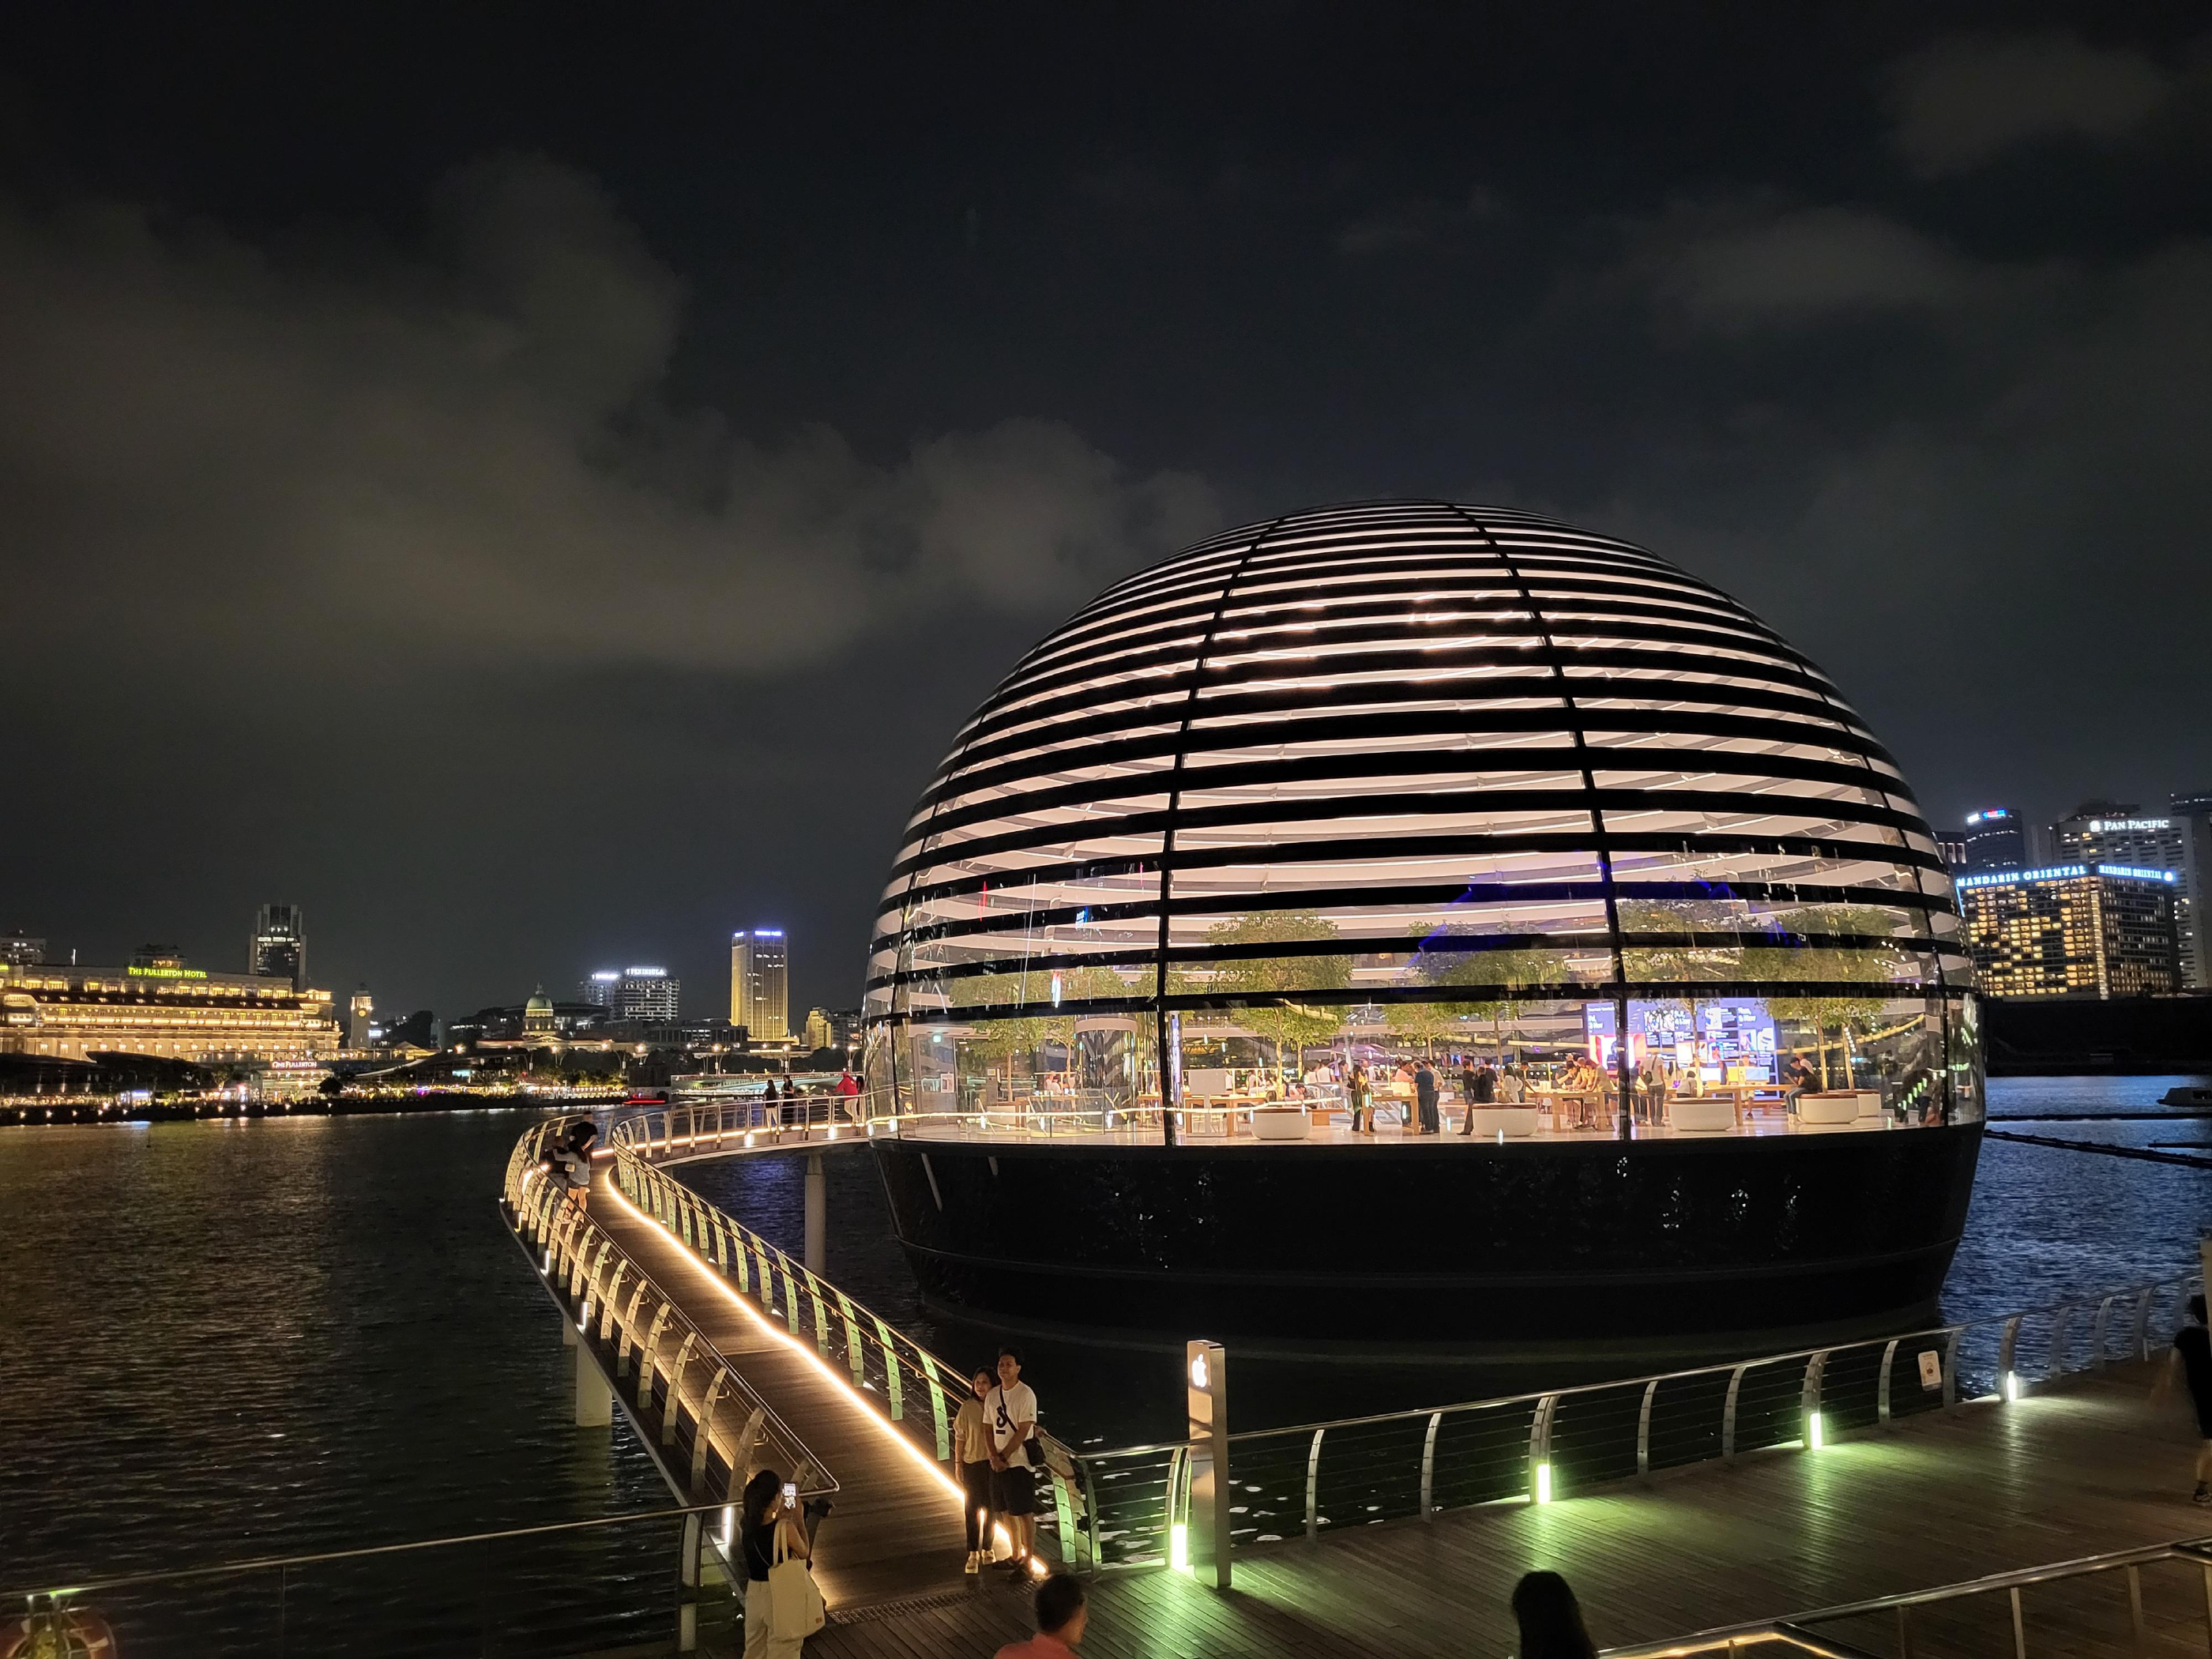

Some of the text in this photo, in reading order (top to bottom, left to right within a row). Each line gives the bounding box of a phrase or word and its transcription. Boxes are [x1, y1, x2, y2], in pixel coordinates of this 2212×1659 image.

[2104, 820, 2169, 830] PAN PACIFIC
[1956, 865, 2086, 886] MANDARIN ORIENTAL
